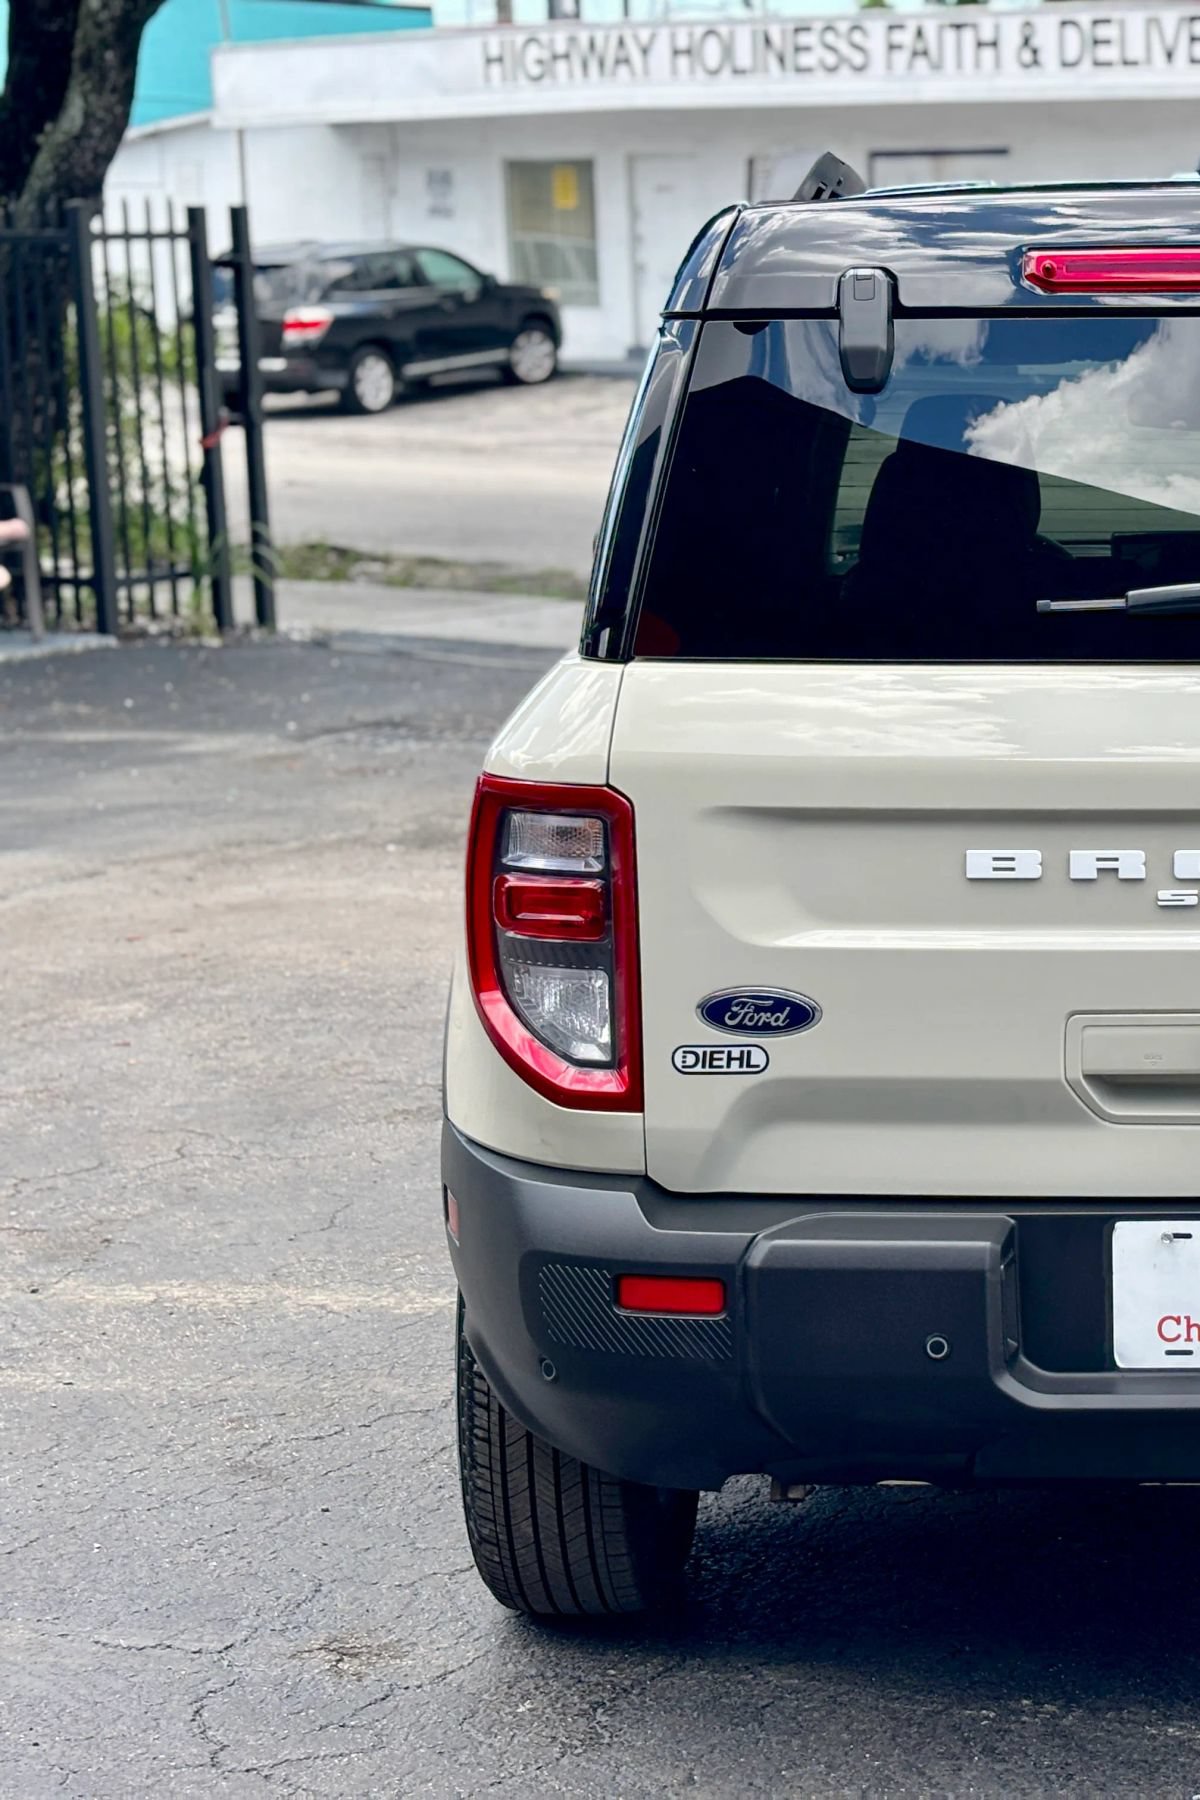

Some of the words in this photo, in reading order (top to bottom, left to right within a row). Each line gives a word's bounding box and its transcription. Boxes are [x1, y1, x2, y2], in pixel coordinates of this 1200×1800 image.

[483, 33, 656, 84] HIGHWAY
[669, 25, 869, 76] HOLINESS
[886, 22, 1001, 72] FAITH
[1016, 22, 1042, 70] &
[724, 998, 790, 1026] Ford
[681, 1050, 760, 1069] DIEHL
